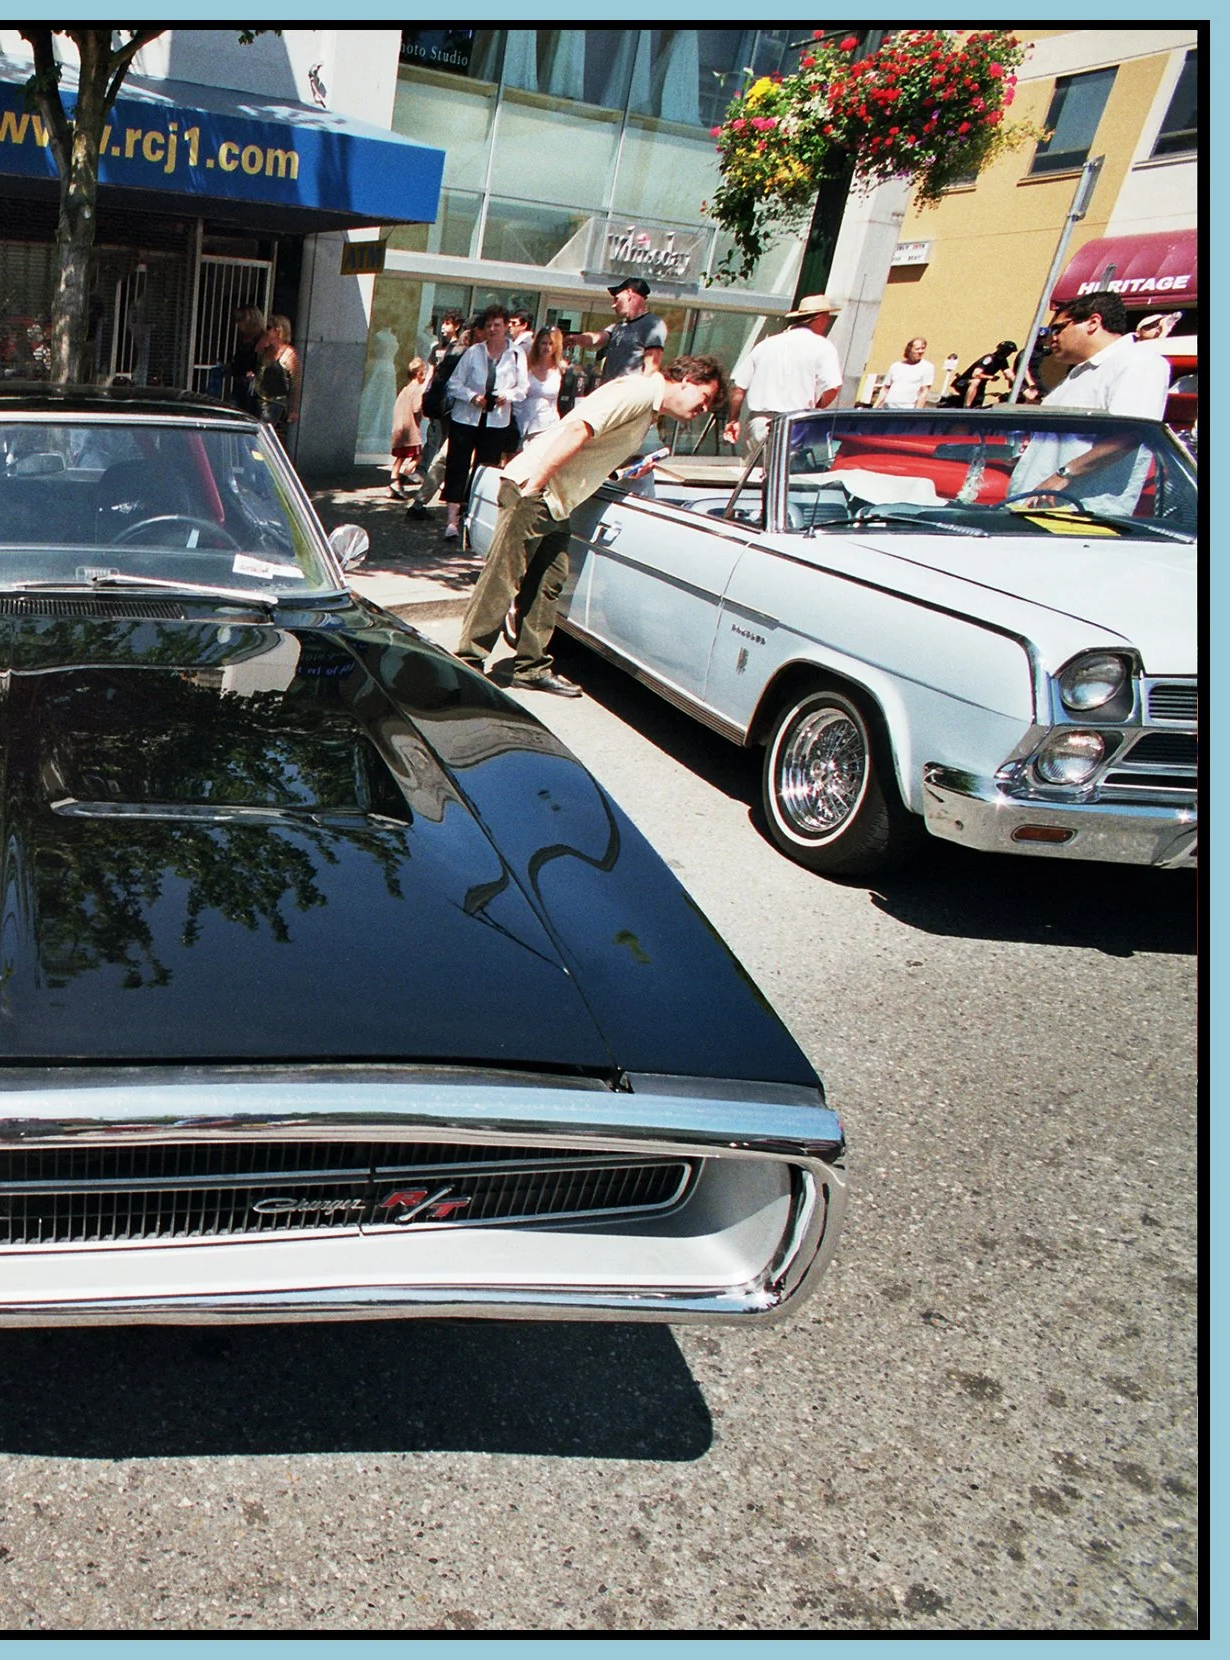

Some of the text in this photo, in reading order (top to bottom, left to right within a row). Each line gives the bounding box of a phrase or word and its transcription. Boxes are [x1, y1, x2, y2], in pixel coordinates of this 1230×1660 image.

[400, 43, 469, 66] hoto Studio
[253, 1185, 472, 1223] Charger R/T
